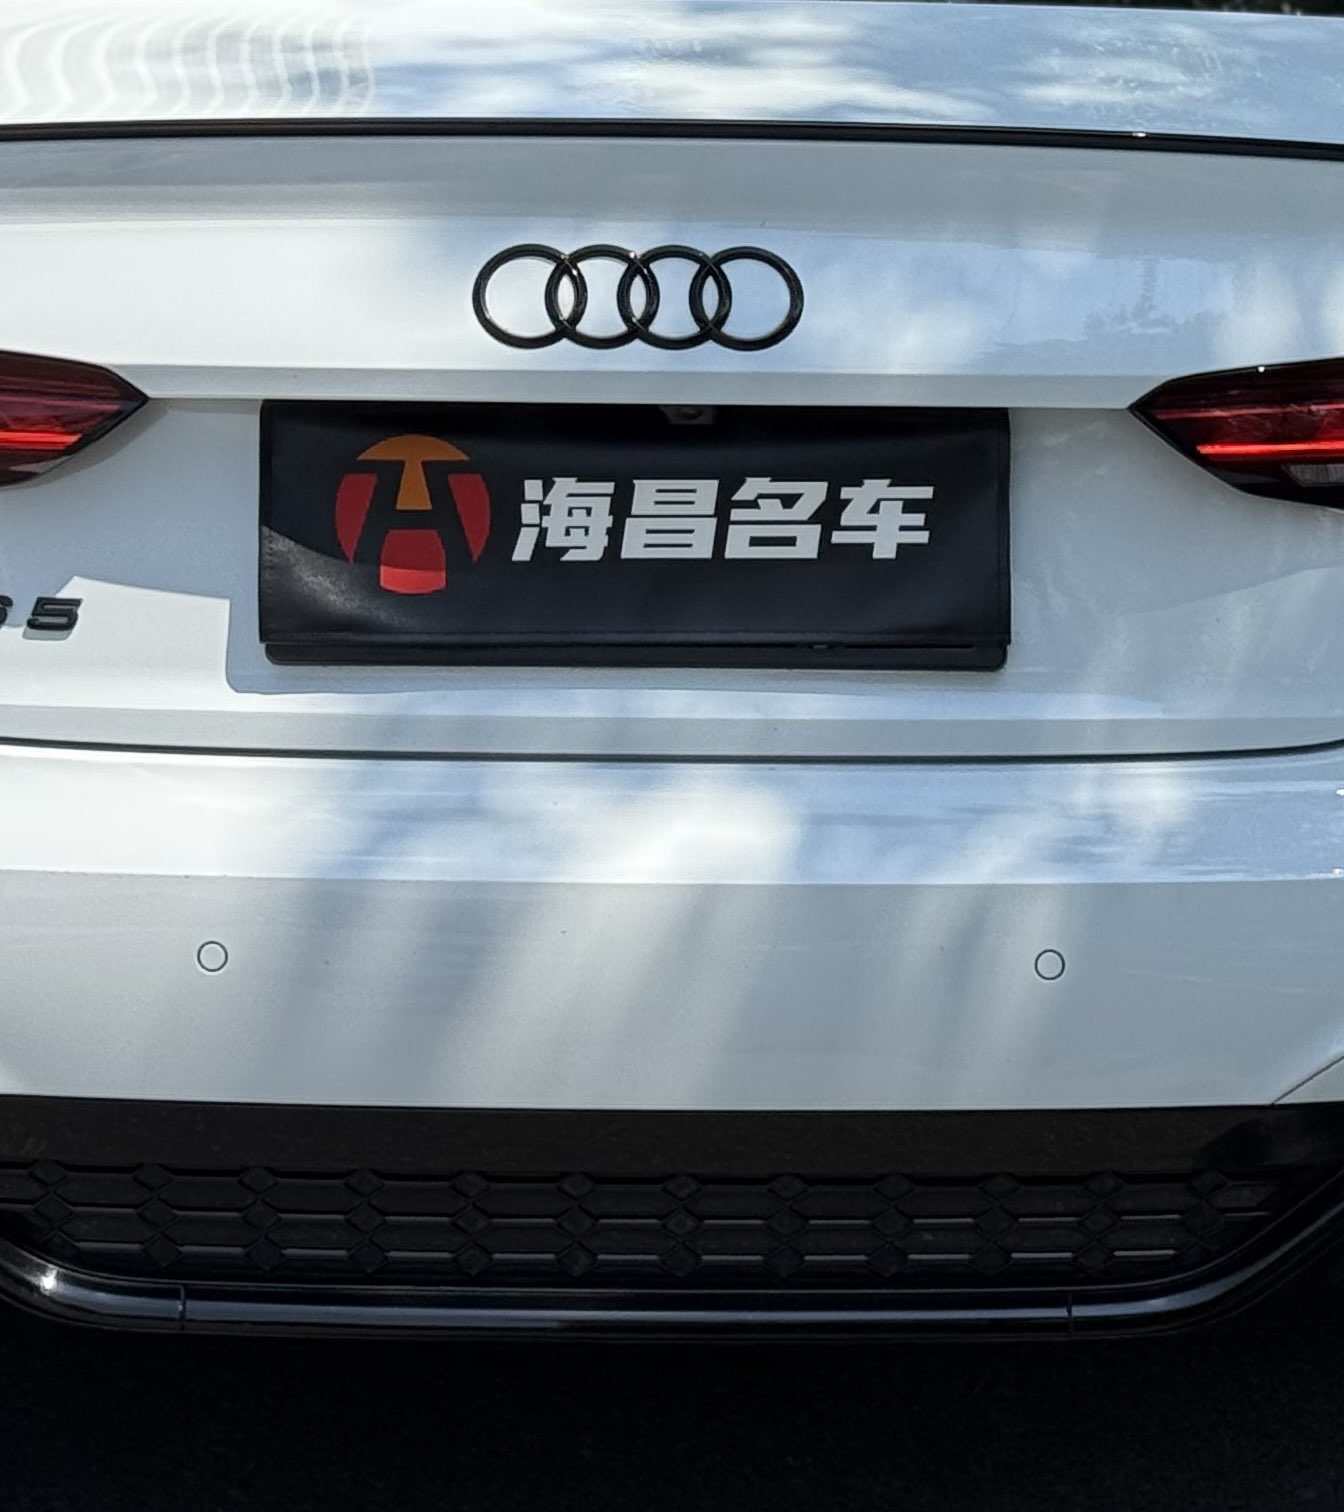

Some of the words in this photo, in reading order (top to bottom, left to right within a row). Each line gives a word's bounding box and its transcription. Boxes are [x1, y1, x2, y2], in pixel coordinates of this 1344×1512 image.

[511, 476, 935, 562] 海昌名车
[26, 595, 83, 631] 5
